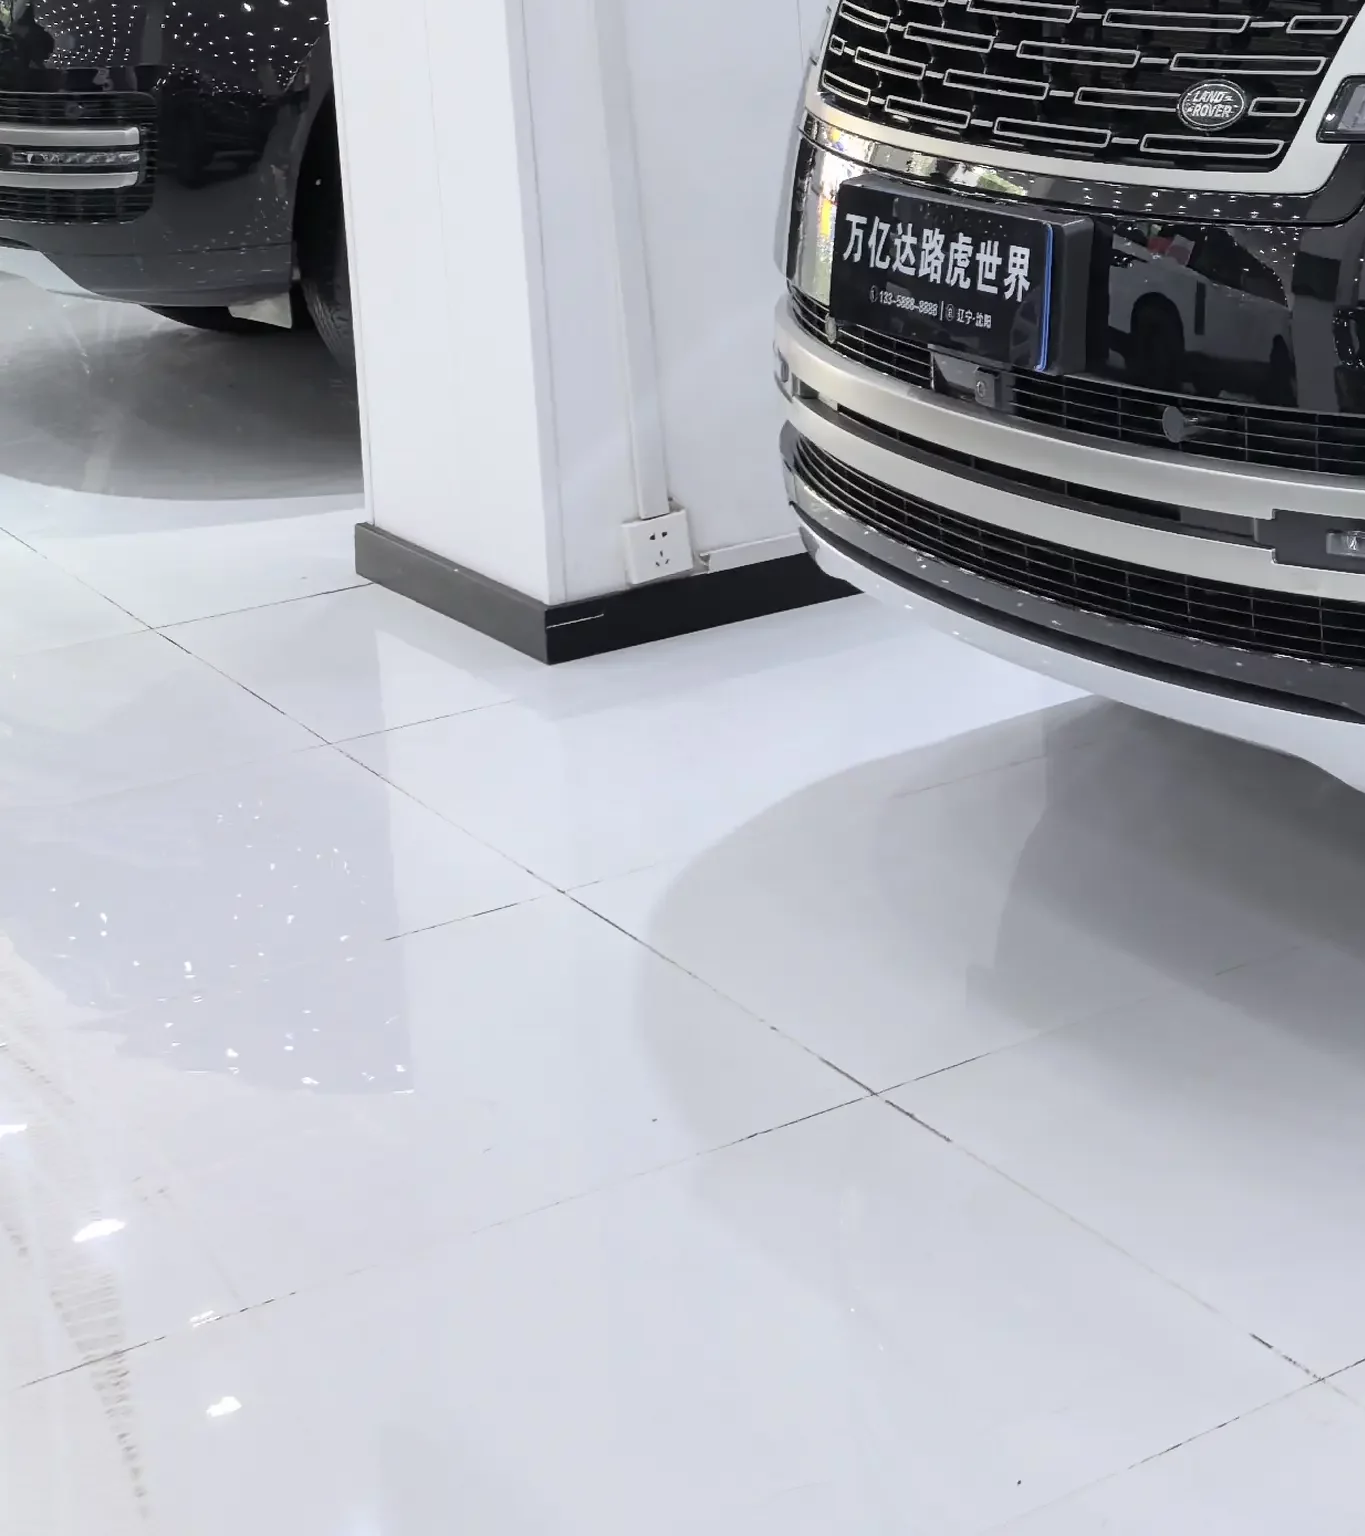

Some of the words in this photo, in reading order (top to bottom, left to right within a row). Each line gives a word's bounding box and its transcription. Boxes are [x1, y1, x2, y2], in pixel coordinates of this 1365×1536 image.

[1192, 90, 1226, 103] LAND
[1192, 102, 1233, 118] ROVER
[843, 213, 1031, 302] 万亿达路虎世界
